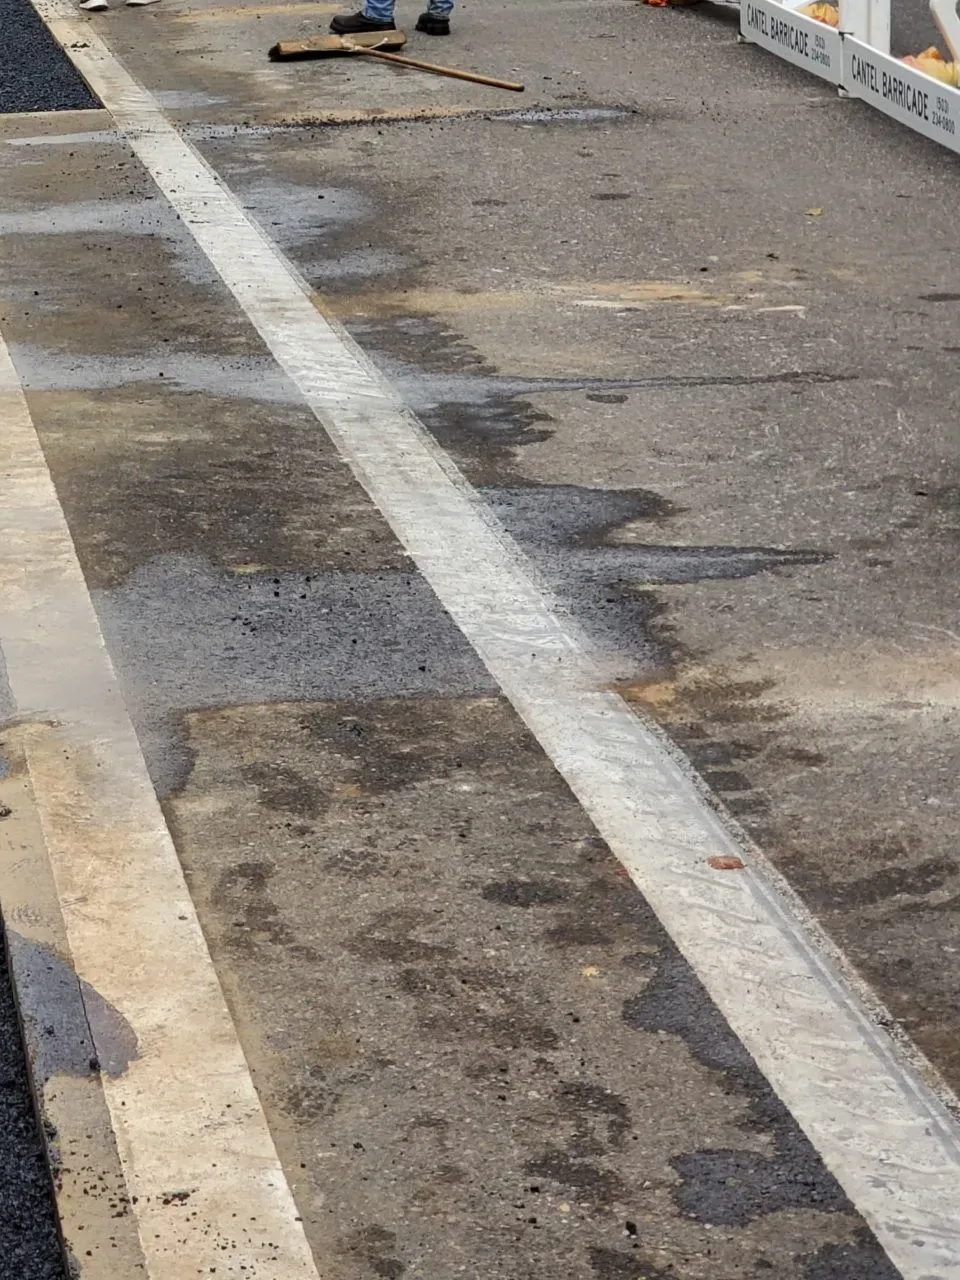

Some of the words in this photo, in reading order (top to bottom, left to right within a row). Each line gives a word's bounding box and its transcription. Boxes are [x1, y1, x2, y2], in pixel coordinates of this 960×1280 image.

[746, 3, 769, 36] CANTEL
[770, 16, 809, 57] BARRICADE
[851, 53, 880, 94] CANTEL
[882, 71, 929, 121] BARRICADE
[931, 110, 956, 135] 234-0800
